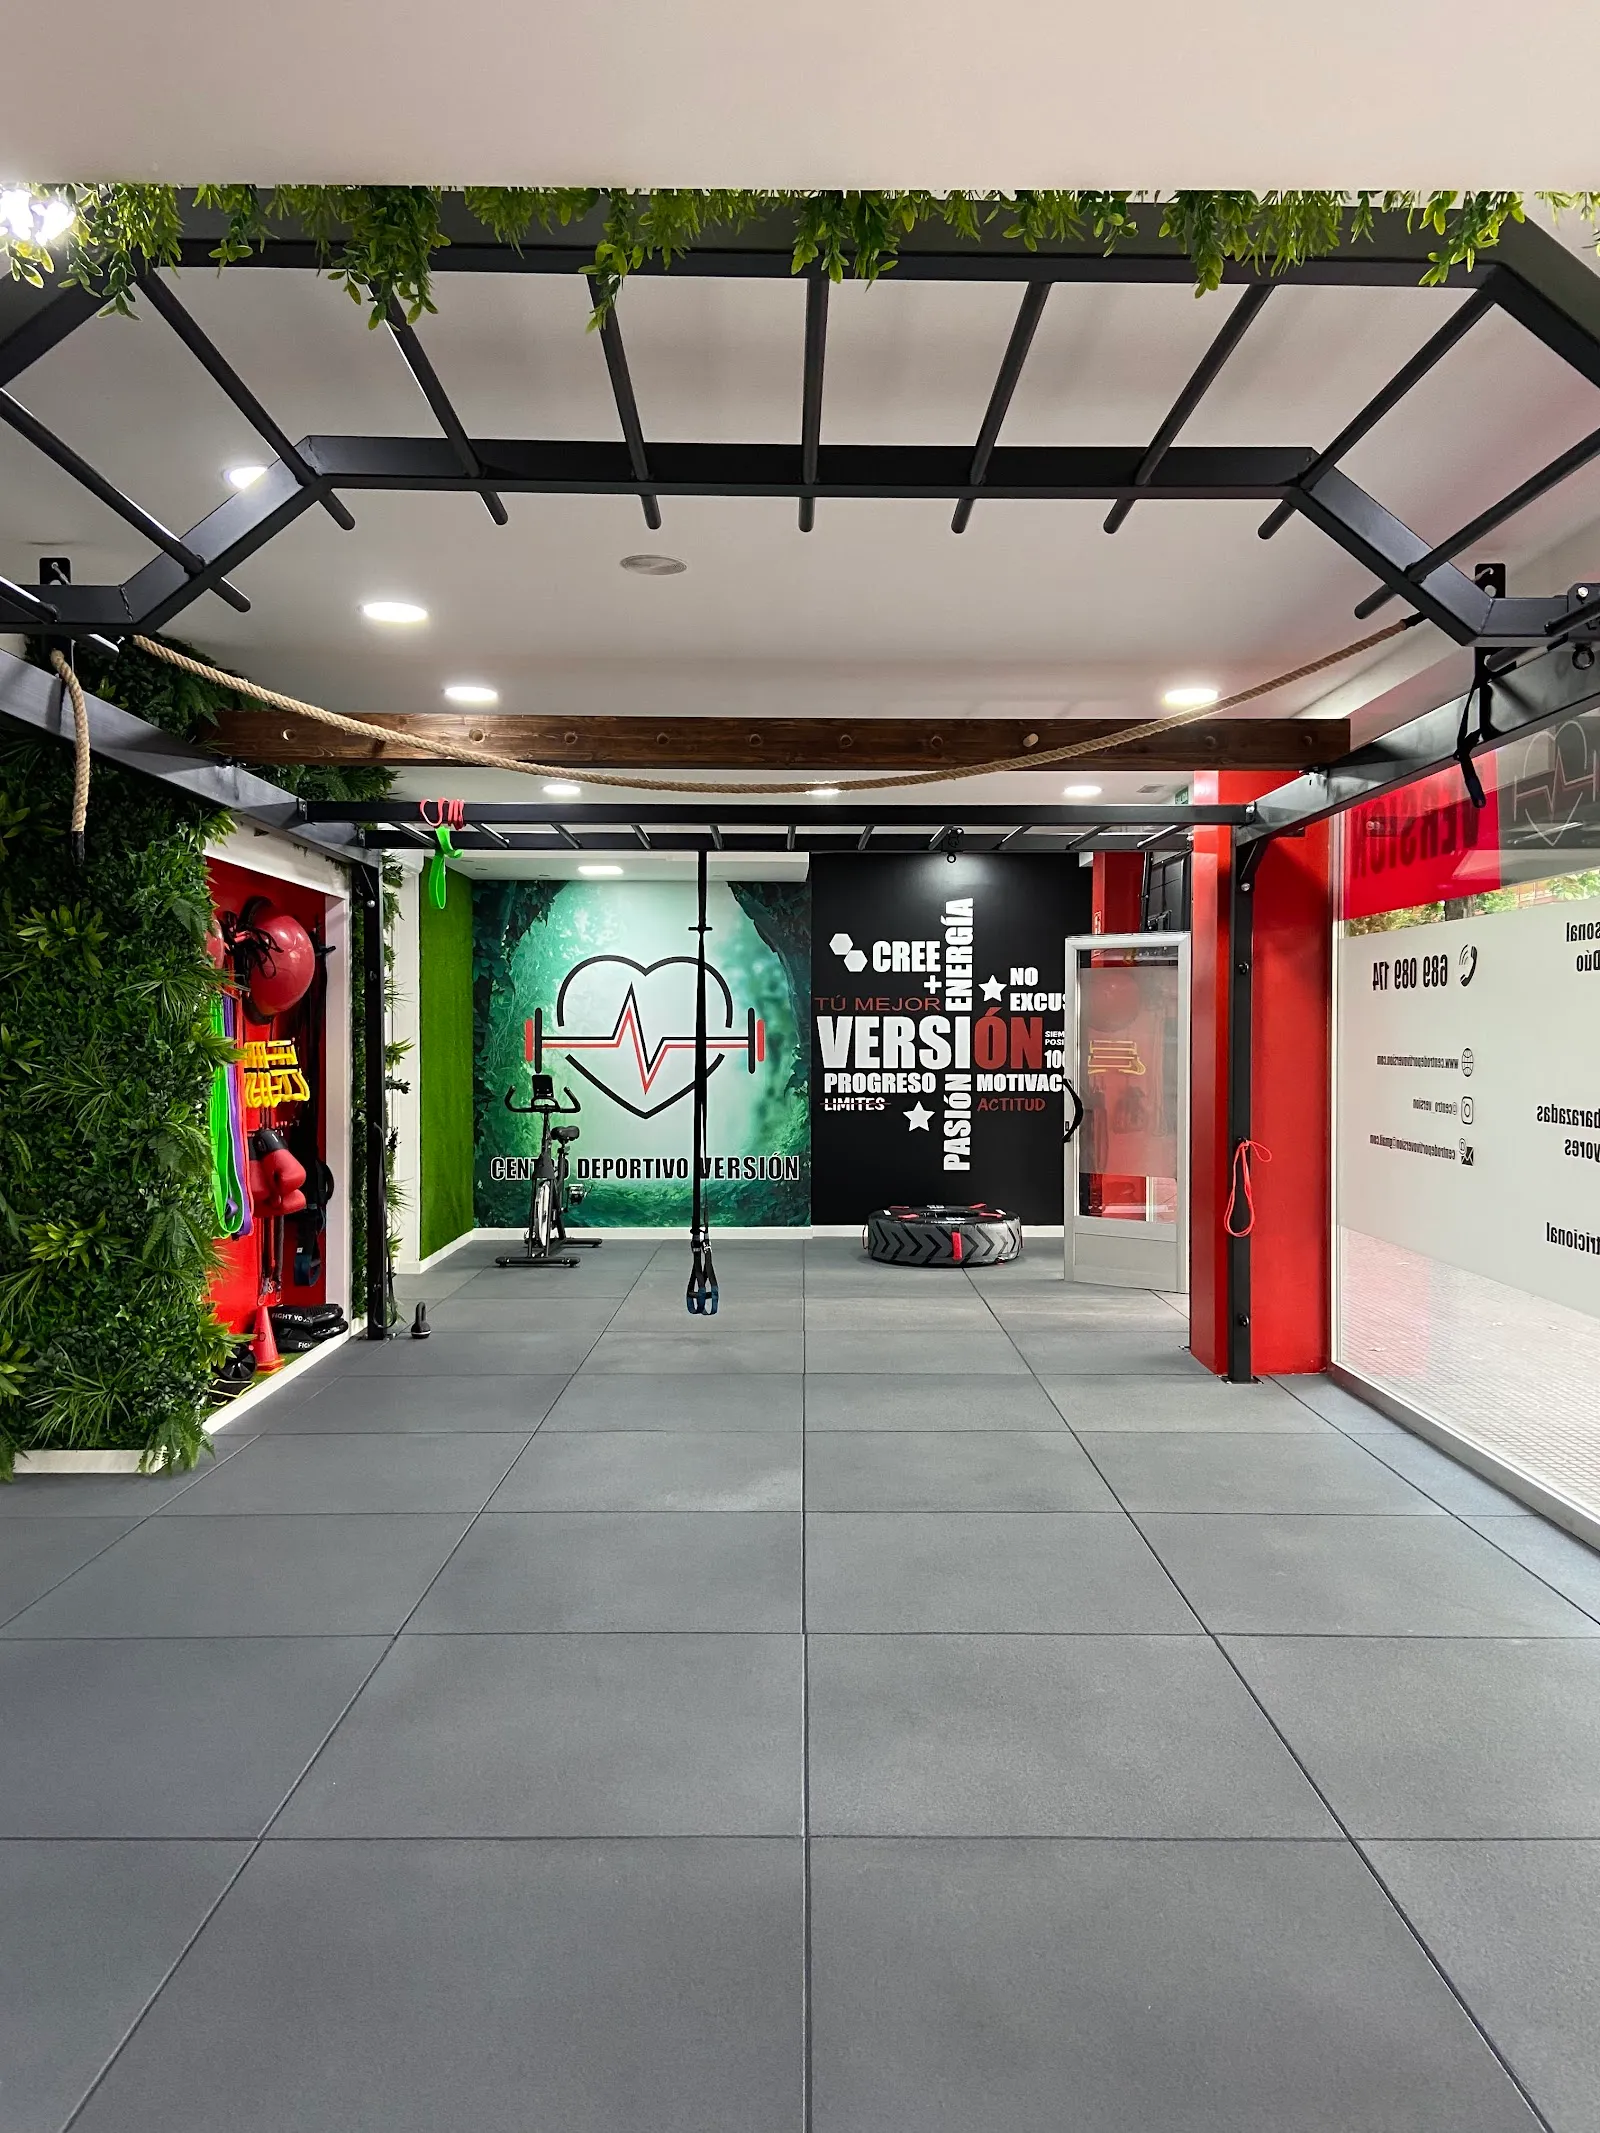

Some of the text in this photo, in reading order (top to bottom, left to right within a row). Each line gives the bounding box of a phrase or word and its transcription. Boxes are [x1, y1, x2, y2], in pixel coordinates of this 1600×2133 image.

[872, 940, 942, 973] CREE
[940, 897, 974, 1012] ENERGÍA
[1009, 966, 1039, 987] NO
[814, 994, 941, 1012] TÚ MEJOR
[1009, 992, 1066, 1012] EXCU
[816, 1006, 1043, 1071] VERSIÓN
[823, 1072, 937, 1094] PROGRESO
[824, 1096, 886, 1112] LIMITES
[976, 1097, 1046, 1112] ACTITUD
[943, 1073, 972, 1171] PASIÓN
[576, 1156, 690, 1181] DEPORTIVO
[699, 1151, 800, 1181] VERSIÓN
